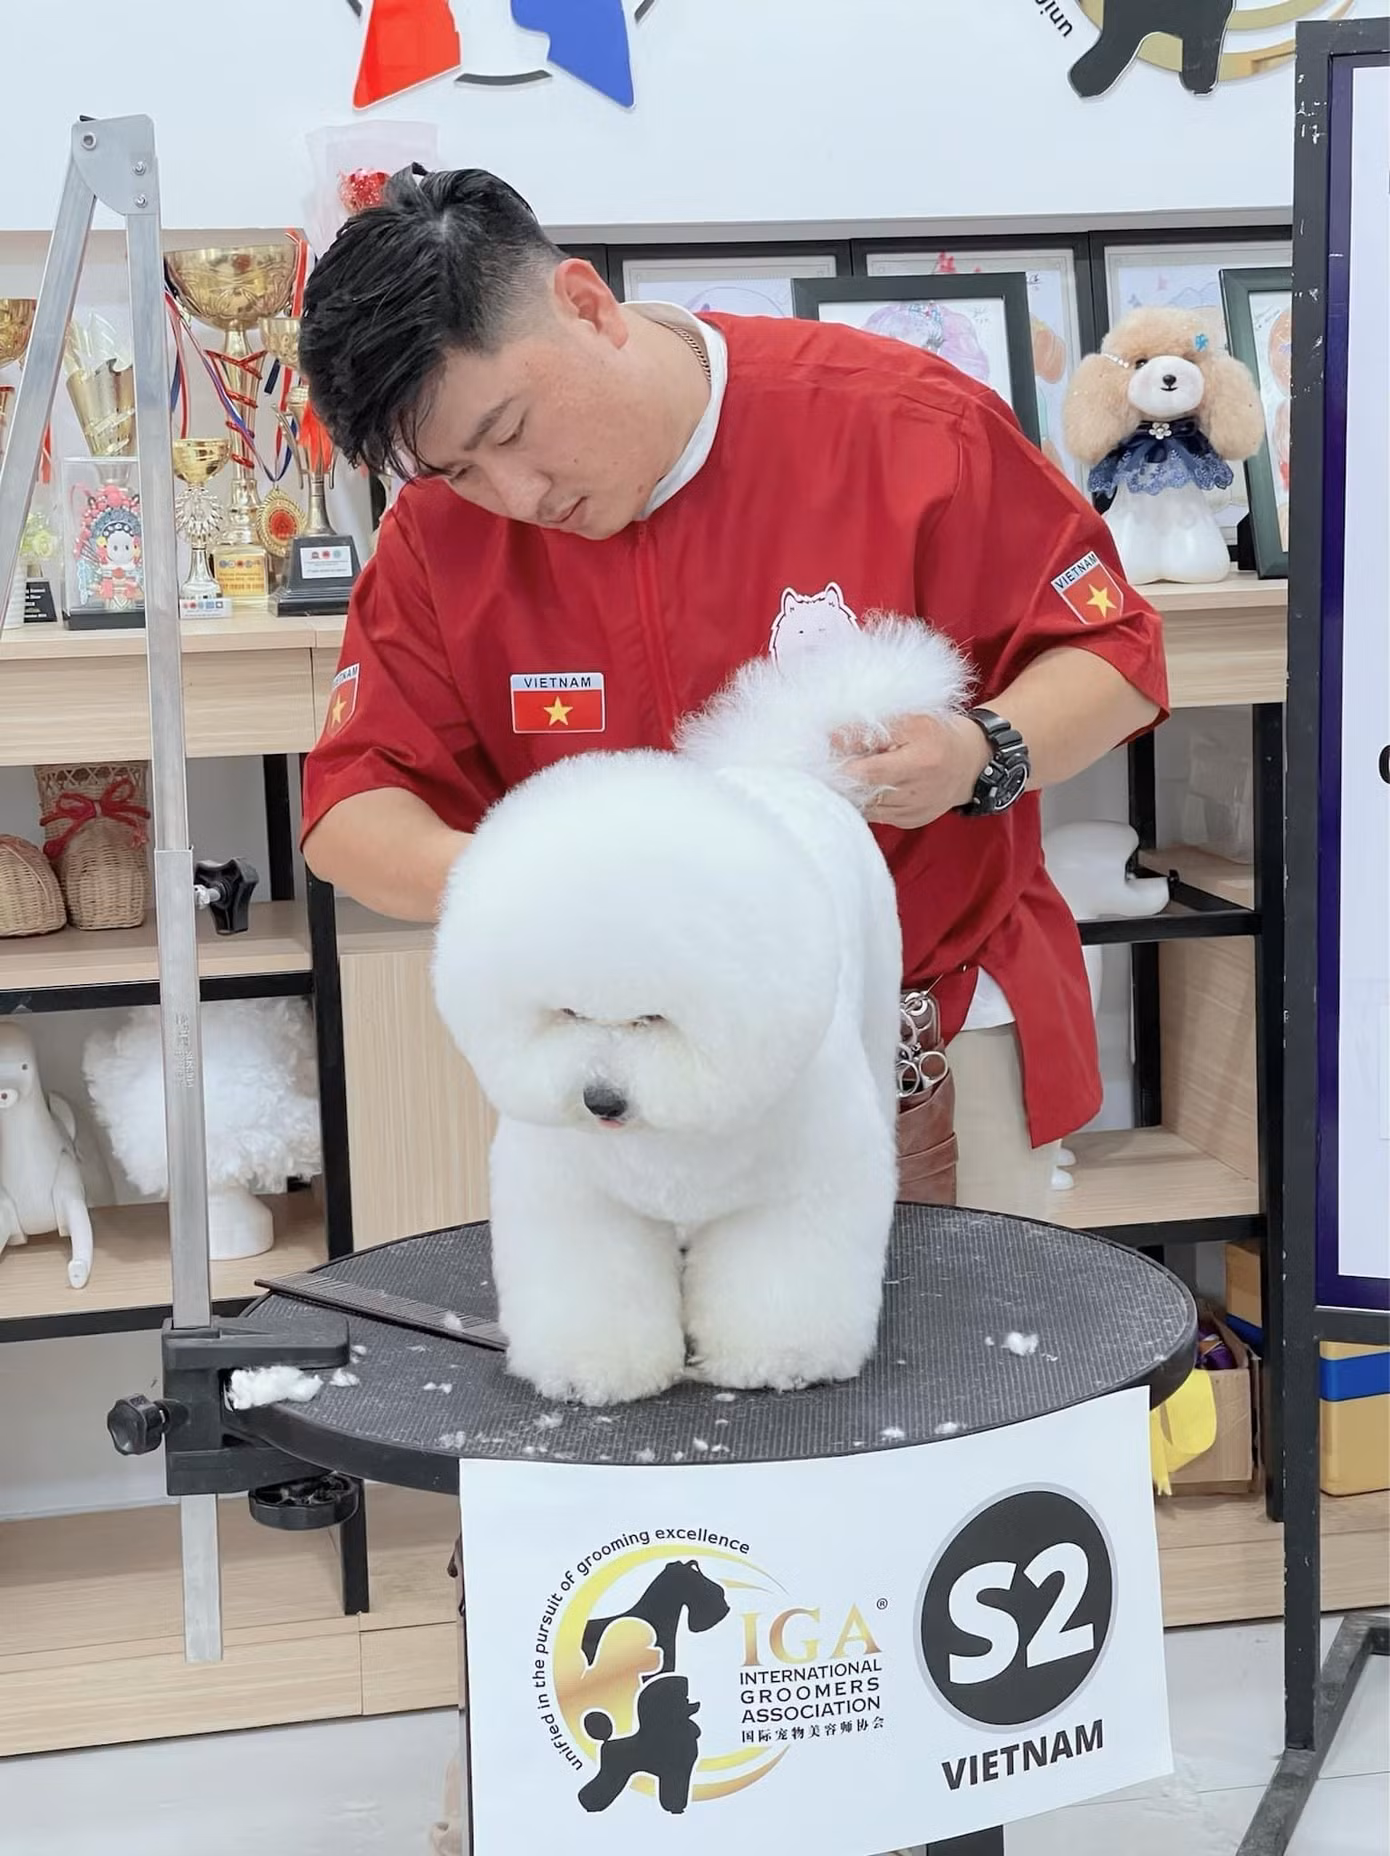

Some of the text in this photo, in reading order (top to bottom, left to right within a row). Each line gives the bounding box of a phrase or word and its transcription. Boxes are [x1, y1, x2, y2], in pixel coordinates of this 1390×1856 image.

[1053, 553, 1097, 589] VIETNAM
[523, 677, 591, 688] VIETNAM
[948, 1542, 1095, 1685] S2
[532, 1527, 750, 1771] unified in the pursuit of grooming excellence
[739, 1602, 883, 1667] IGA
[740, 1659, 882, 1686] INTERNATIONAL
[740, 1677, 880, 1705] GROOMERS
[741, 1696, 881, 1724] ASSOCIATION
[742, 1715, 885, 1743] 国际宠物美容师协会
[941, 1718, 1104, 1791] VIETNAM
